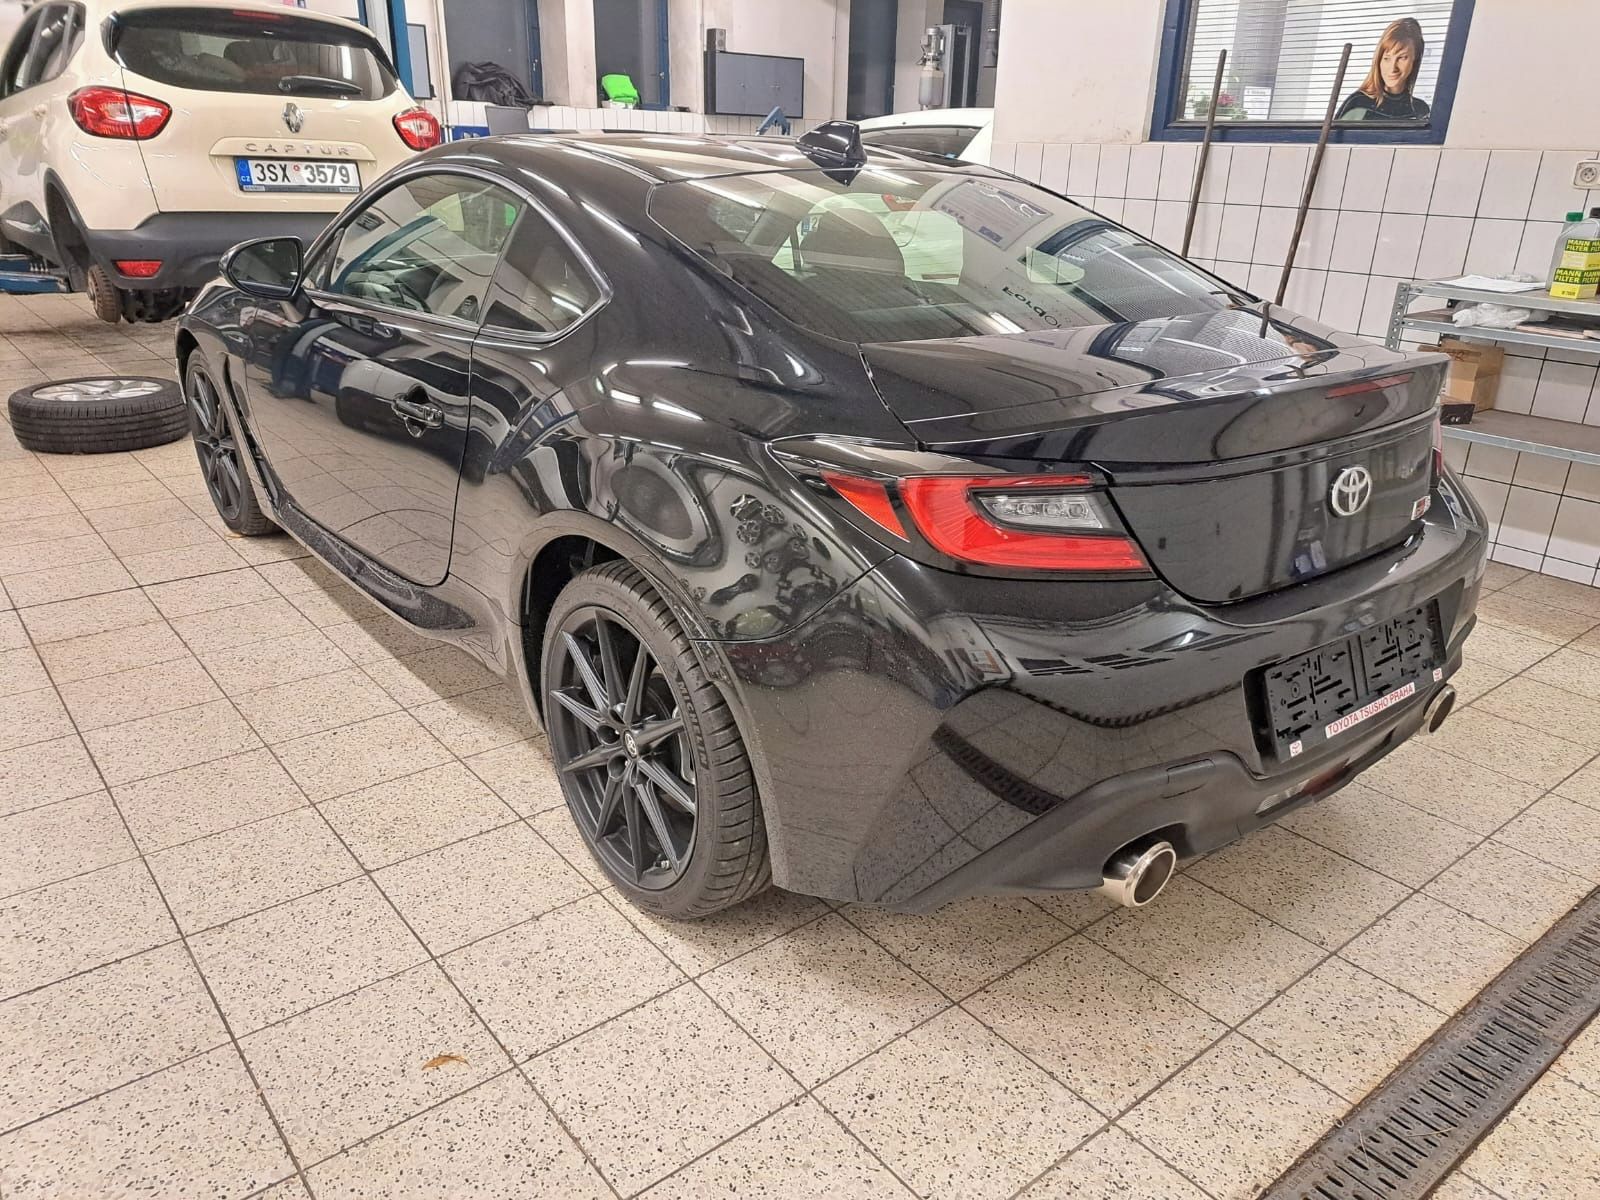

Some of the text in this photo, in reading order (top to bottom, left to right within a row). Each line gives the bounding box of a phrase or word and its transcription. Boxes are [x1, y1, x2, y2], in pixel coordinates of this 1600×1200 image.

[245, 143, 350, 156] CAPTUR
[254, 163, 350, 184] 3SX 3579
[1554, 275, 1580, 283] FILTER
[1556, 269, 1582, 277] MANN
[1327, 684, 1413, 735] TOYOTA TSUSHO PRAHA
[678, 681, 709, 770] MICHELIN
